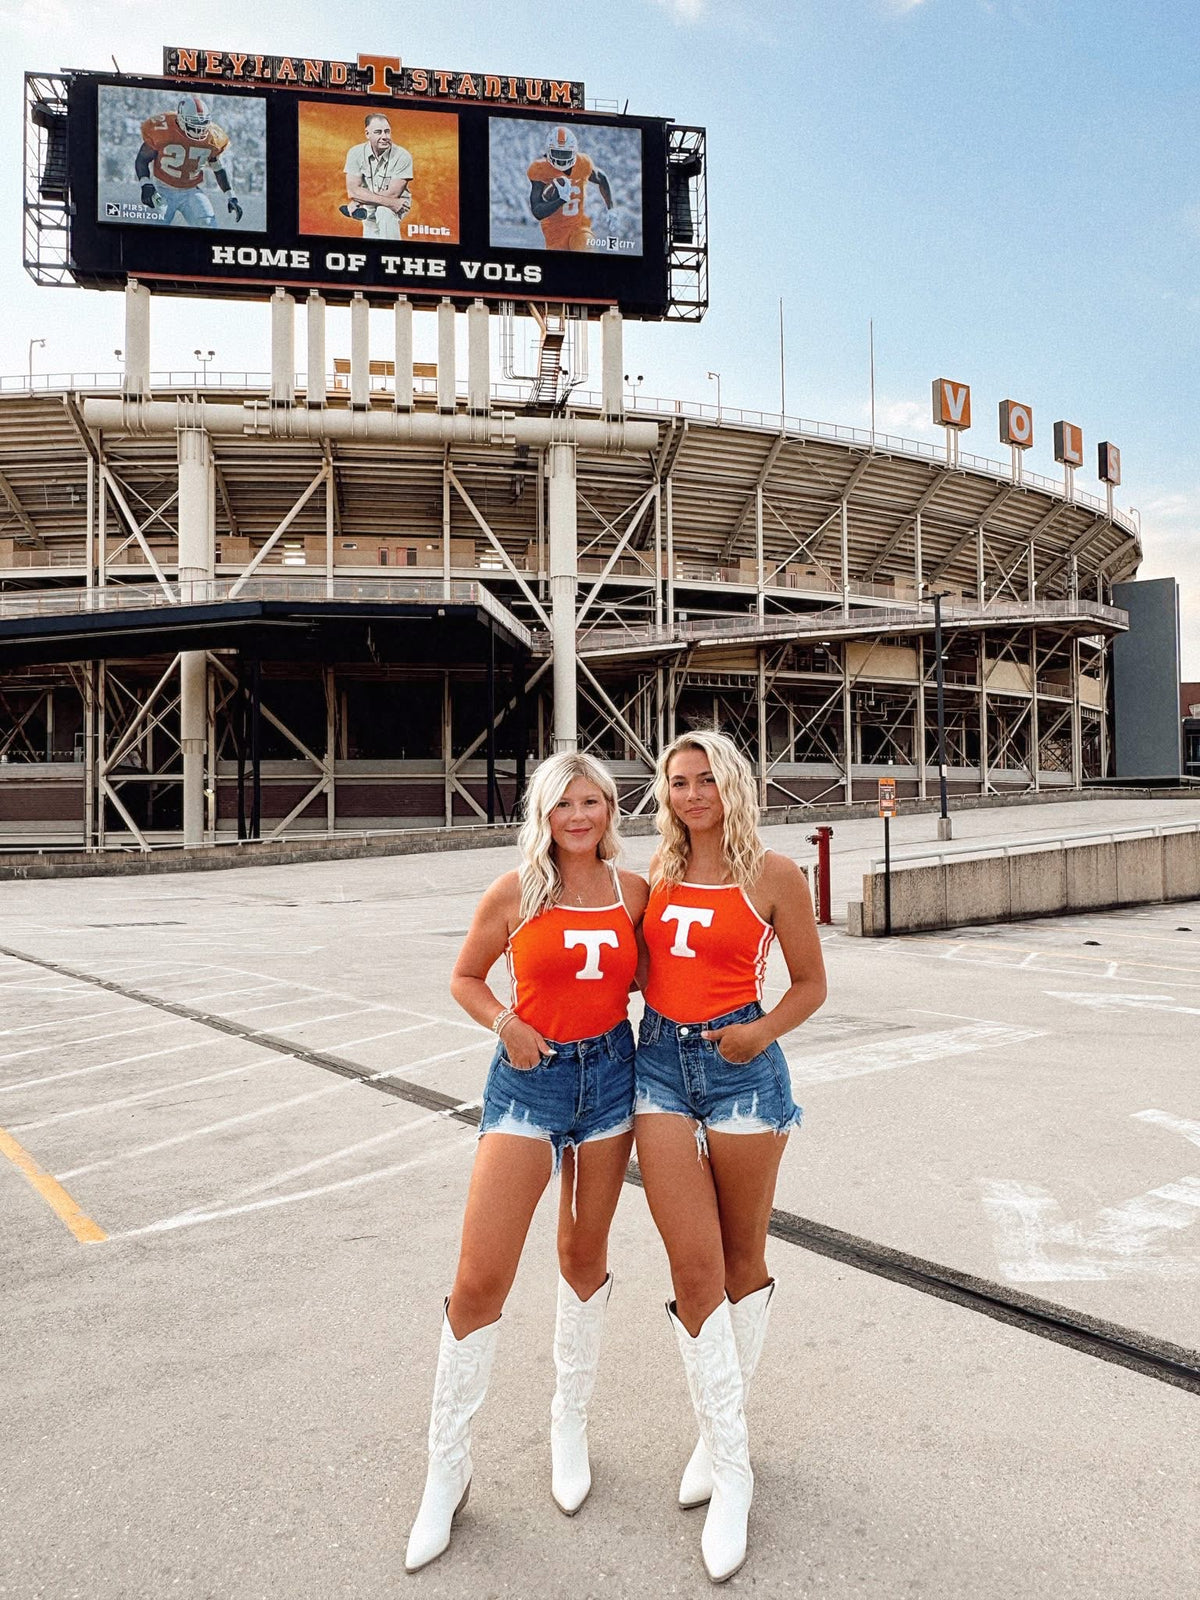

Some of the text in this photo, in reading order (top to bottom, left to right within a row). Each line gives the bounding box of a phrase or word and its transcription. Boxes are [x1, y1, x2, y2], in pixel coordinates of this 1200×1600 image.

[177, 48, 572, 103] NEYLAND T STADIUM
[160, 143, 212, 181] 27
[122, 203, 149, 212] FIRST
[122, 211, 165, 220] HORIZON
[586, 238, 607, 247] FOOD
[619, 240, 636, 249] CITY
[211, 245, 542, 283] HOME OF THE VOLS
[943, 383, 968, 422] V
[1010, 405, 1031, 441] O
[1065, 425, 1080, 462] L
[660, 904, 715, 958] T
[563, 929, 619, 980] T
